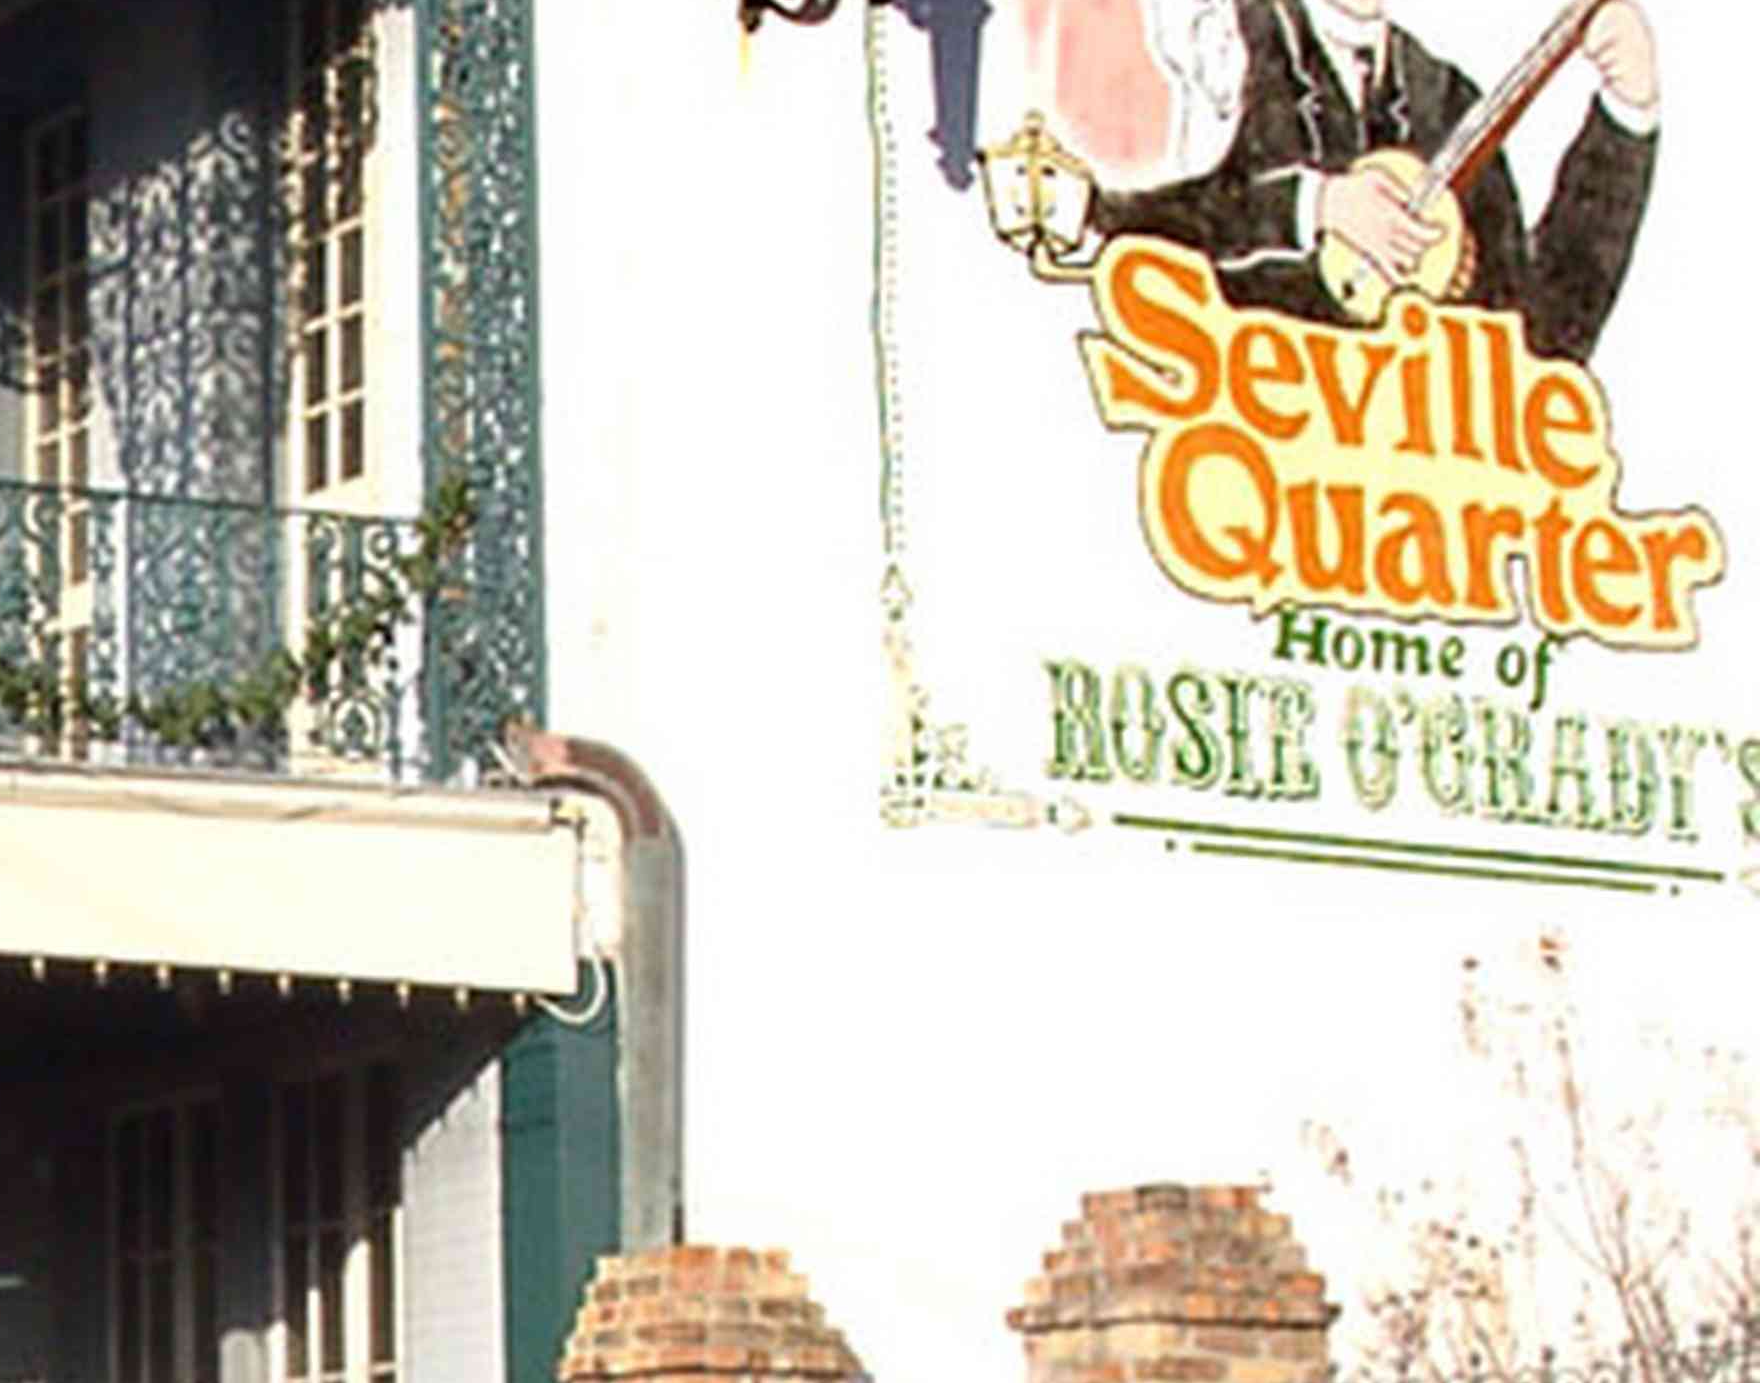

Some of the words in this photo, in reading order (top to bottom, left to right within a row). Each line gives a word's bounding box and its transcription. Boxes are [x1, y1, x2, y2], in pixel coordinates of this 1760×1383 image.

[1105, 249, 1600, 490] Seville
[1158, 422, 1708, 632] Quarter
[1044, 660, 1322, 802] ROSIE
[1273, 608, 1464, 677] Home
[1496, 631, 1563, 710] of
